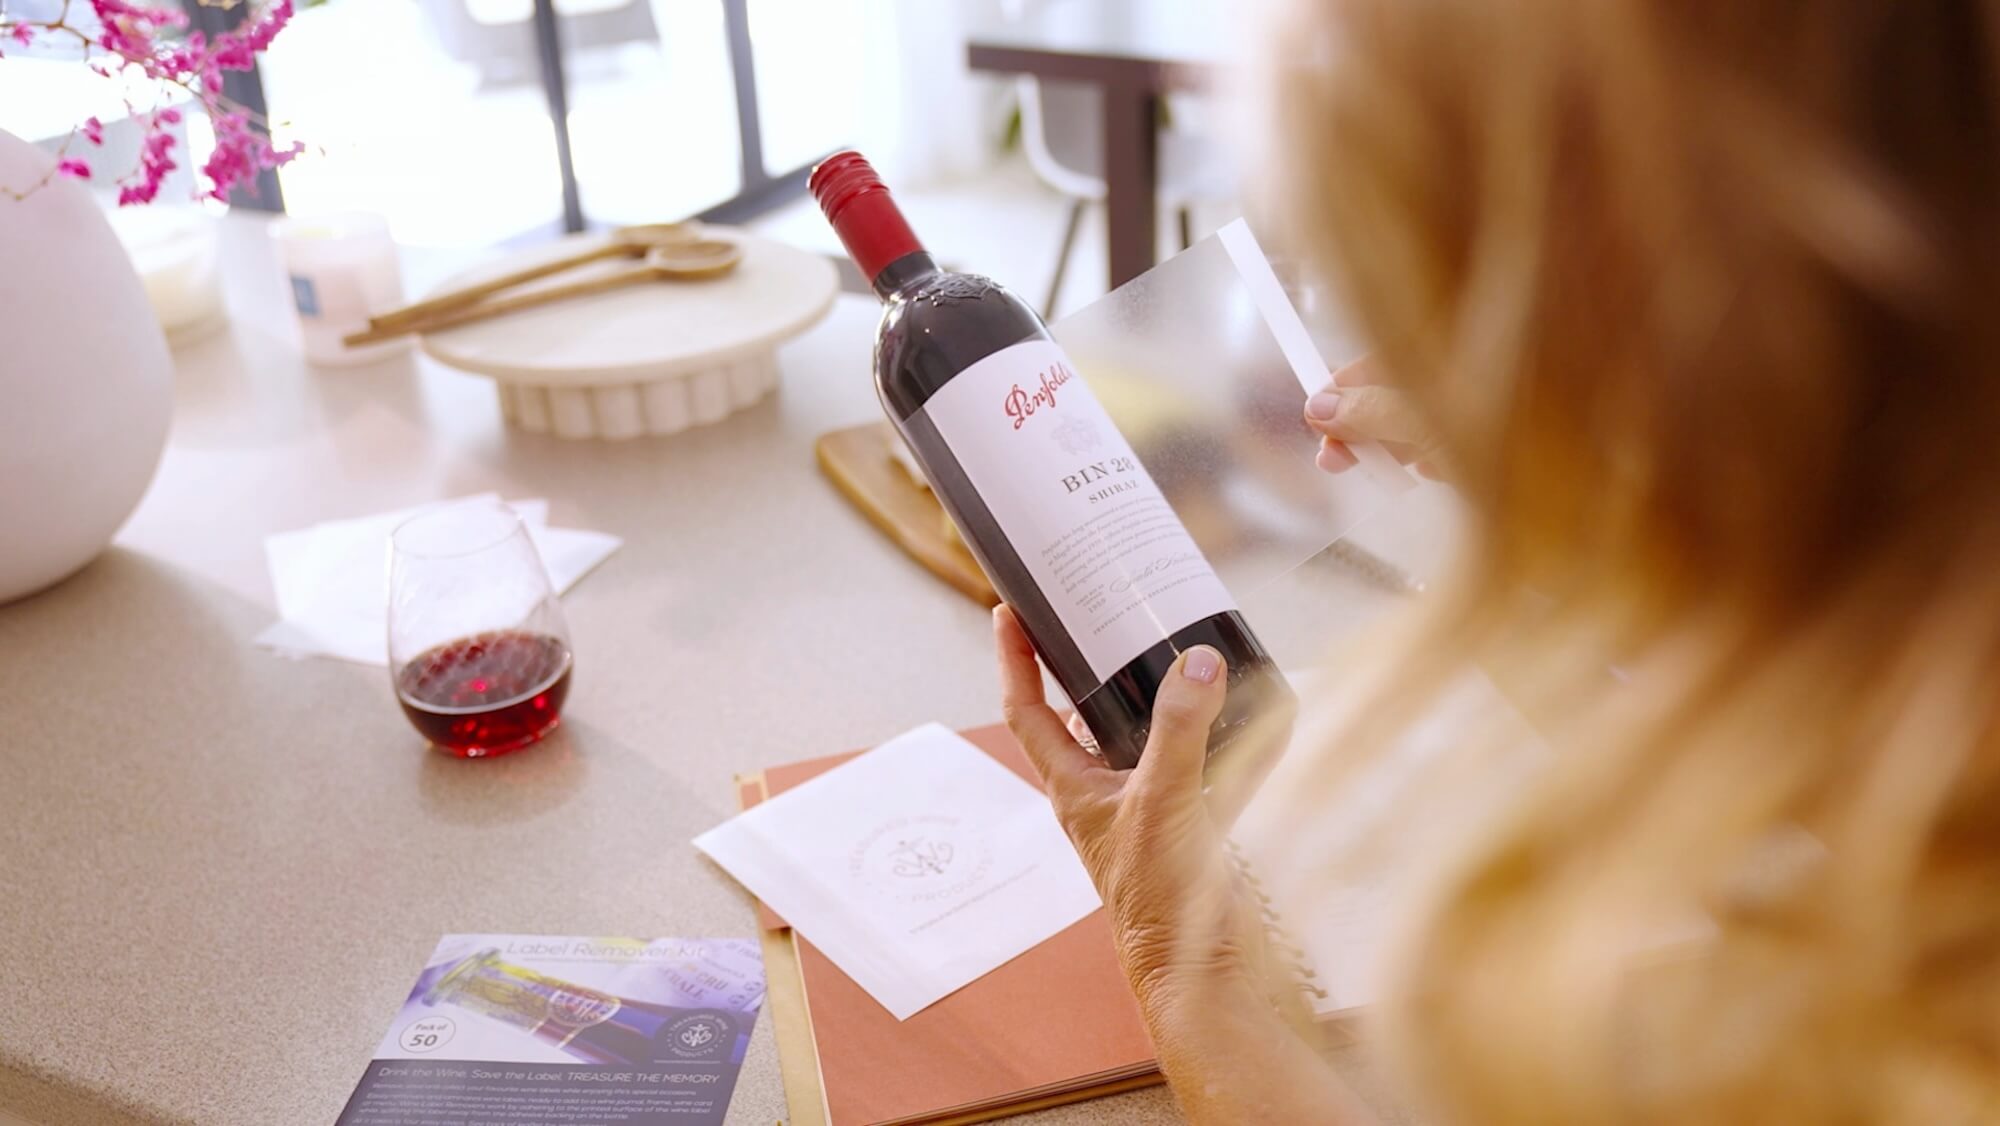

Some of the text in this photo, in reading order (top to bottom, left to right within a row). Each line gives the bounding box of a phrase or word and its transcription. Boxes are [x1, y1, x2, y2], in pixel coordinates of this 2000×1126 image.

[1061, 461, 1109, 494] BIN
[1088, 479, 1139, 504] SHIRAZ
[506, 940, 571, 956] Label
[573, 942, 670, 958] Remover
[415, 1023, 449, 1031] Pack of
[409, 1034, 439, 1047] 50
[378, 1067, 408, 1077] Drink
[412, 1068, 433, 1077] the
[471, 1069, 501, 1079] Save
[505, 1071, 525, 1080] the
[567, 1072, 632, 1083] TREASURE
[637, 1073, 660, 1083] THE
[662, 1074, 720, 1084] MEMORY
